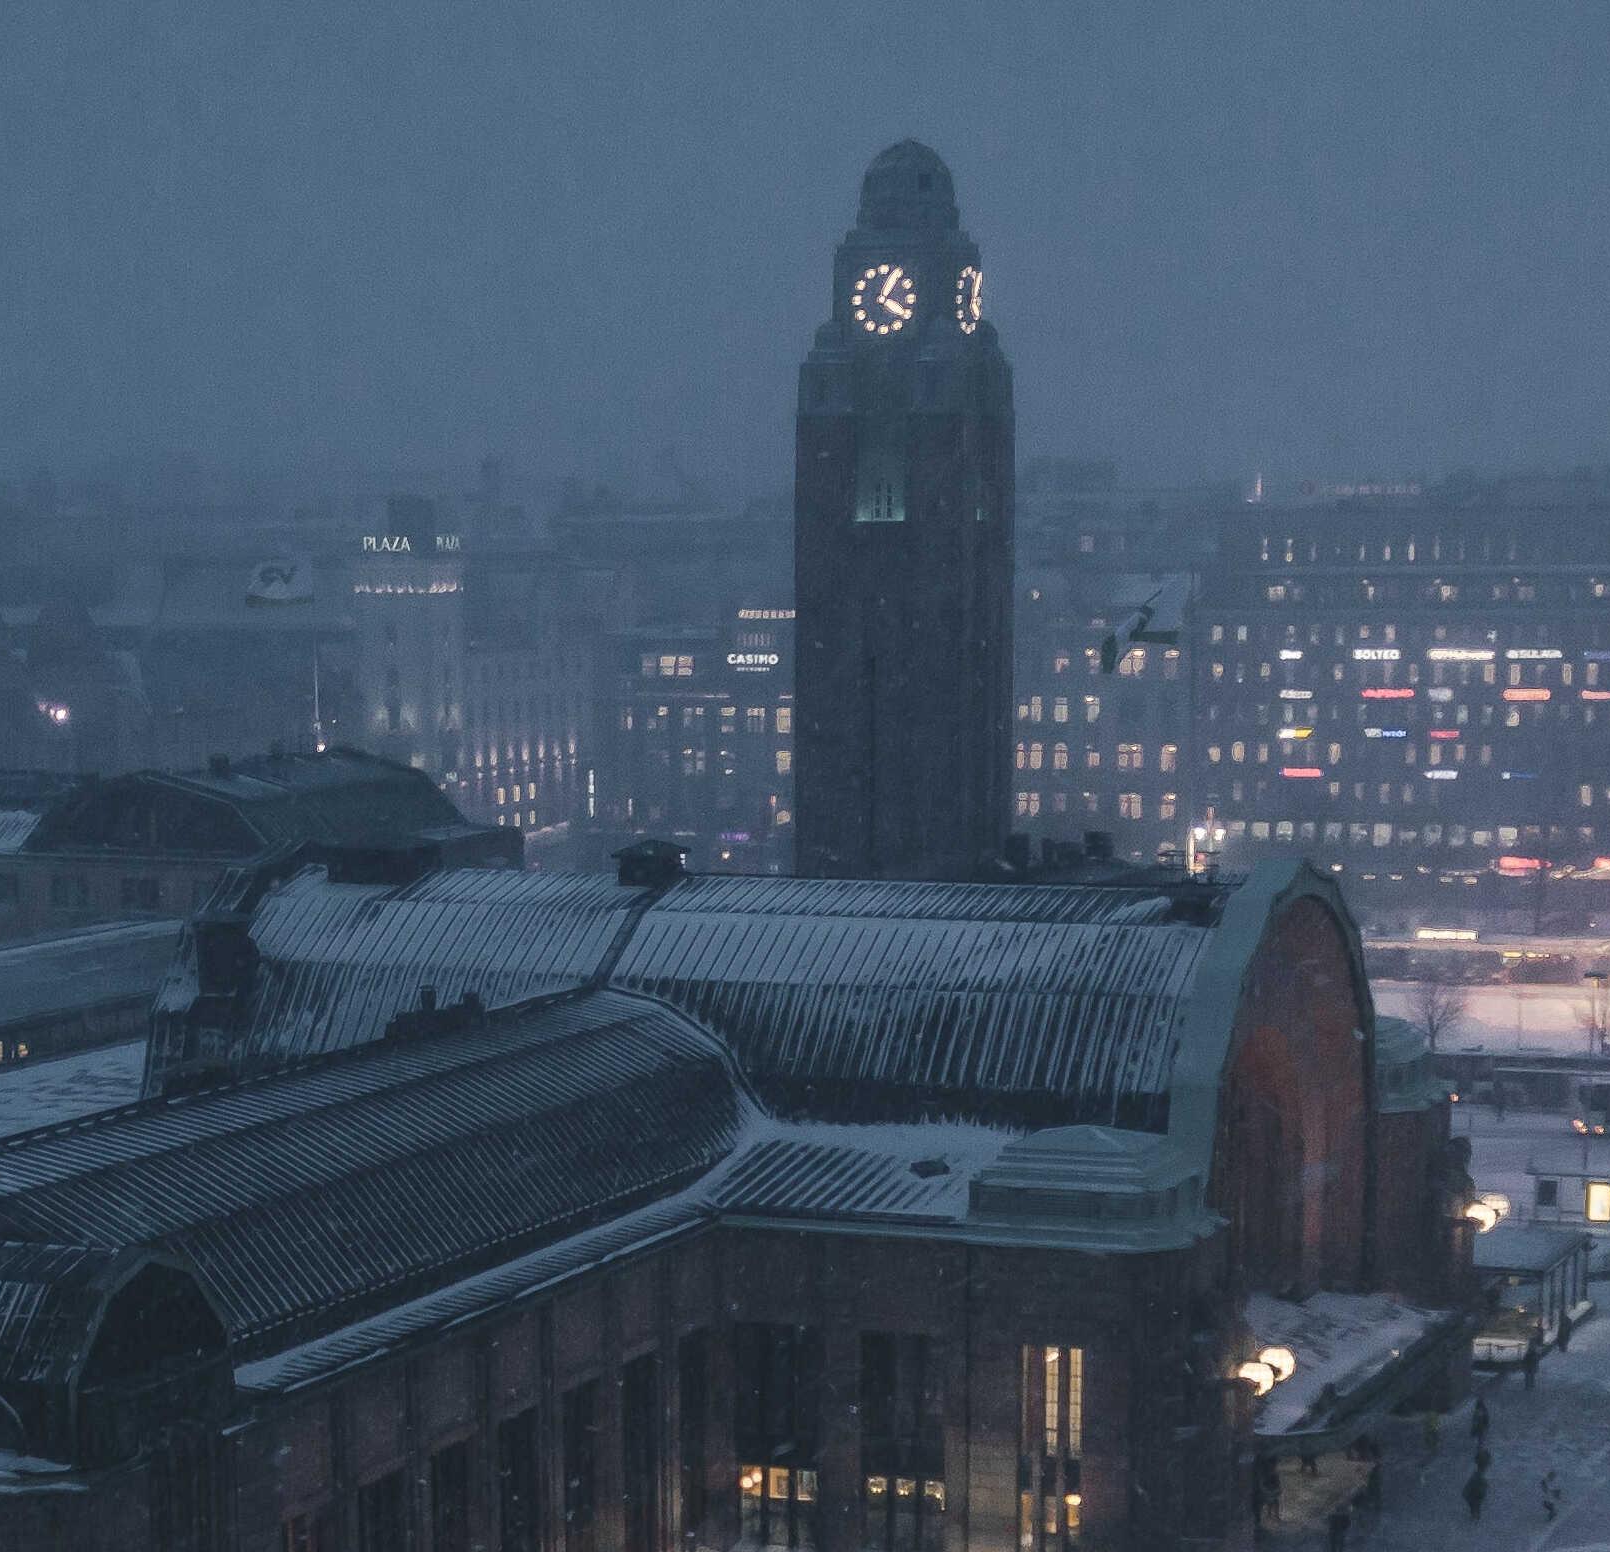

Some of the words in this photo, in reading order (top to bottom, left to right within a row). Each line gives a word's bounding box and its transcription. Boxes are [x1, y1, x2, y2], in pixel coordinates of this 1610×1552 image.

[363, 536, 411, 552] PLAZA
[436, 536, 461, 552] PLAZA
[726, 653, 779, 665] CASINO
